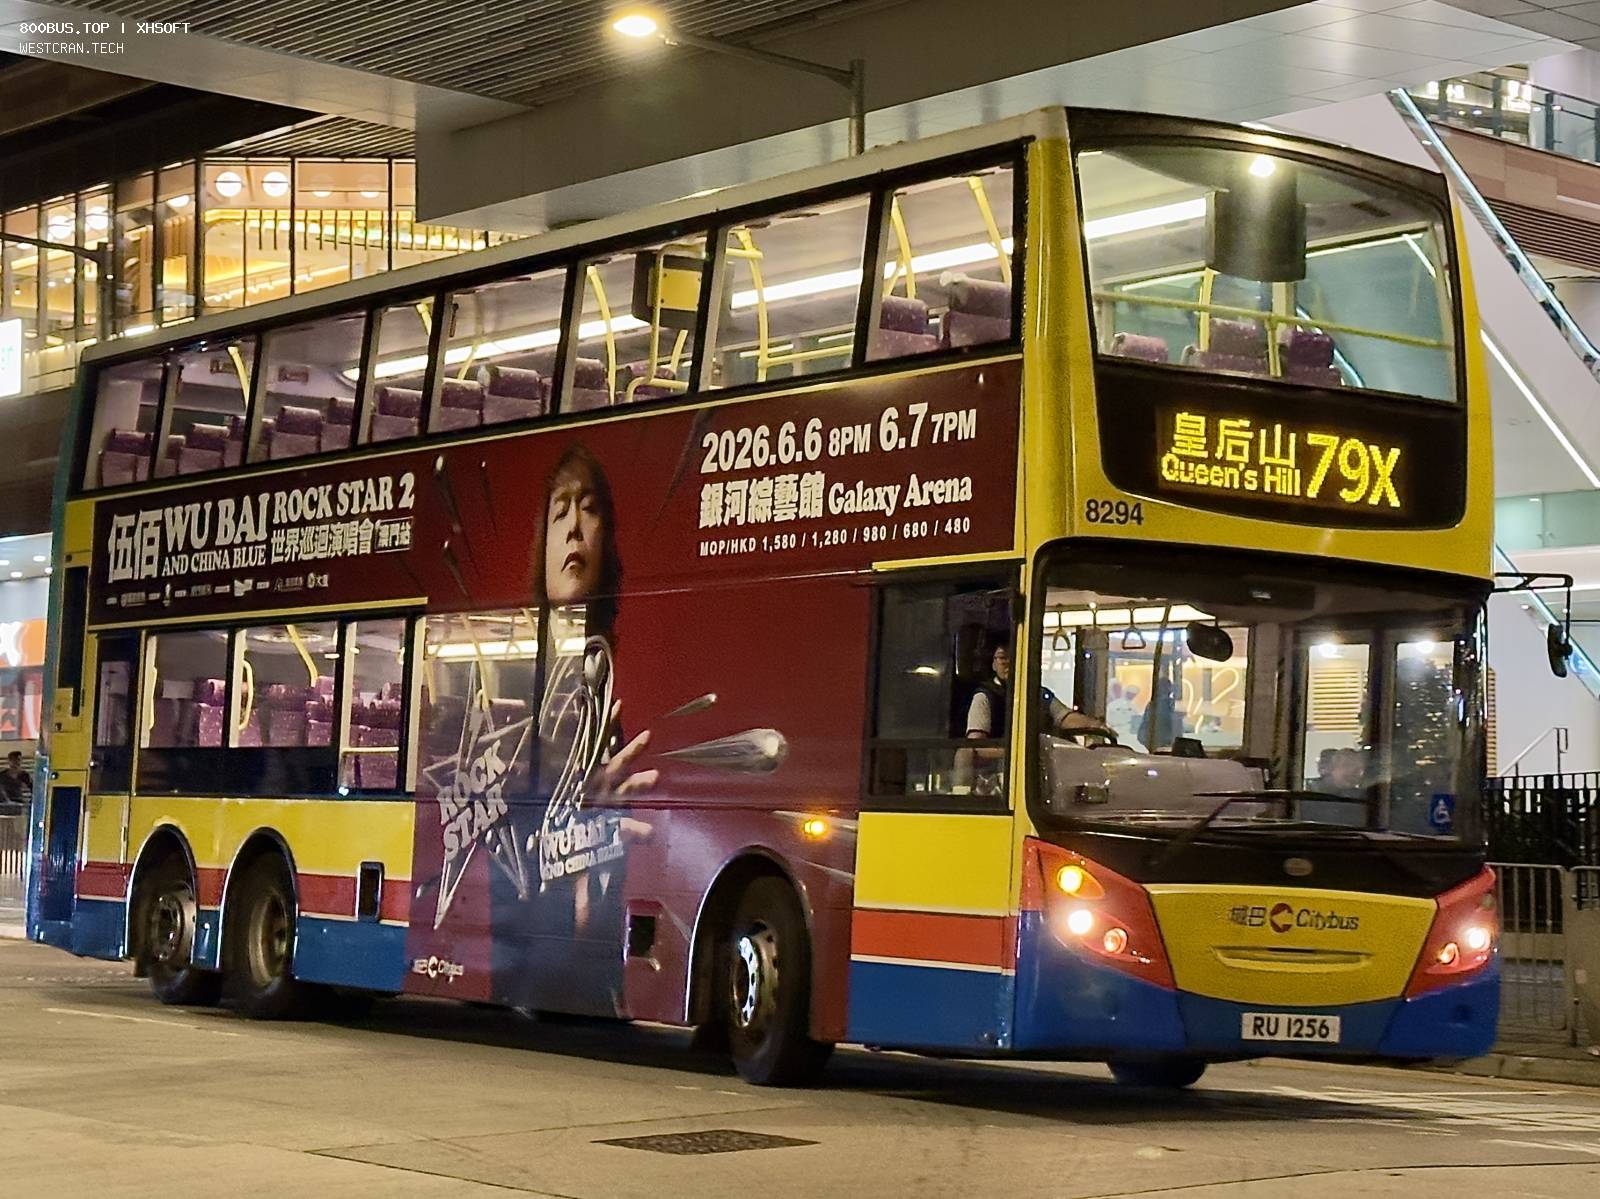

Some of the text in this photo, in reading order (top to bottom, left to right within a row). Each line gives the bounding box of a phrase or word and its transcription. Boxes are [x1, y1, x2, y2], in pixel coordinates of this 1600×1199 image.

[700, 402, 977, 474] 2026.6.6 8PM 6.7 7PM
[1171, 411, 1297, 468] 皇后山
[828, 473, 972, 517] Galaxy Arena
[1161, 450, 1301, 497] Queen's Hill
[1306, 432, 1401, 508] 79X
[163, 492, 271, 552] WU BAI
[273, 472, 415, 524] ROCK STAR 2
[699, 470, 825, 529] 銀河綜藝館
[1085, 499, 1144, 525] 8294
[108, 508, 163, 583] 伍佰
[161, 544, 266, 577] AND CHINA BLUE
[700, 537, 756, 557] MOP/HKD
[762, 533, 797, 553] 1,580
[812, 528, 847, 549] 1,280
[863, 525, 887, 543] 980
[903, 520, 928, 538] 680
[945, 516, 970, 534] 480
[437, 740, 507, 825] ROCK
[443, 783, 508, 862] STAR
[1296, 908, 1360, 931] Citybus
[1253, 1015, 1330, 1039] RU 1256
